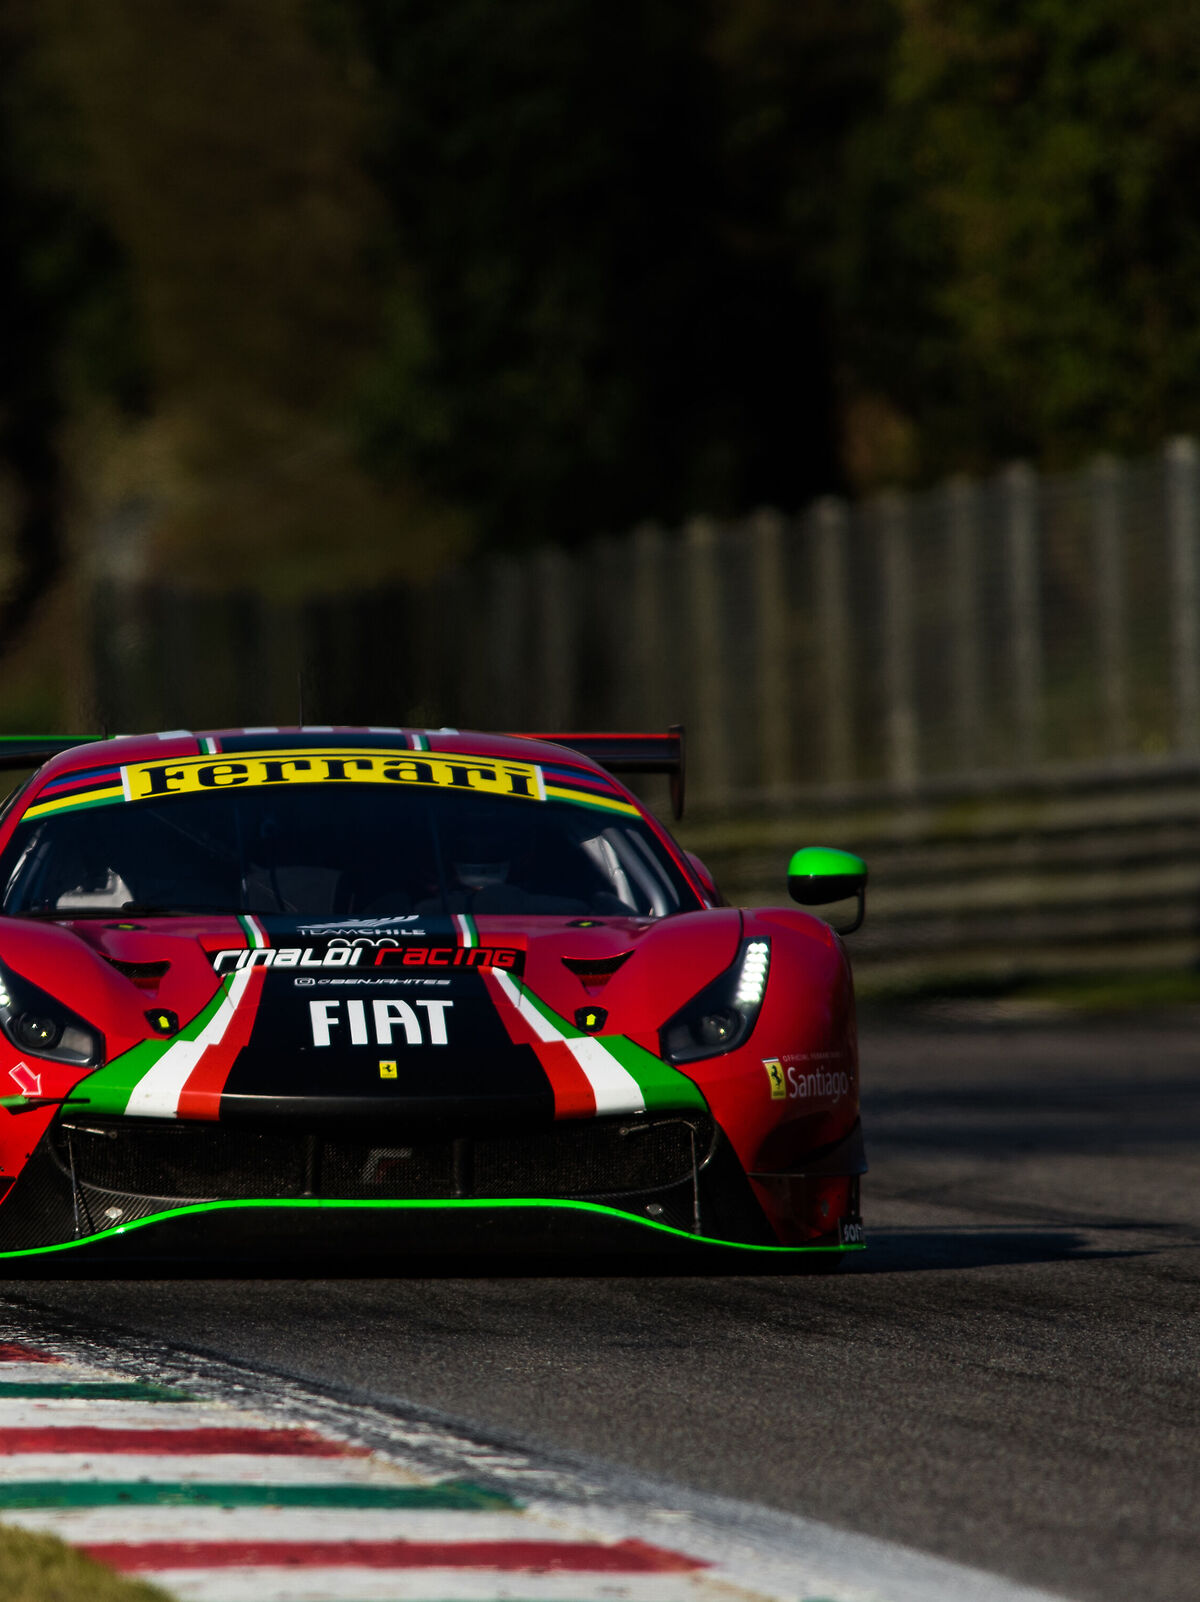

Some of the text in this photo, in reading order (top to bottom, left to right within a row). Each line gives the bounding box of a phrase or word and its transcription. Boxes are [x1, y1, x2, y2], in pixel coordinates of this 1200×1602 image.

[140, 757, 536, 797] Ferrari
[309, 999, 454, 1046] FIAT
[787, 1066, 849, 1104] Santiago
